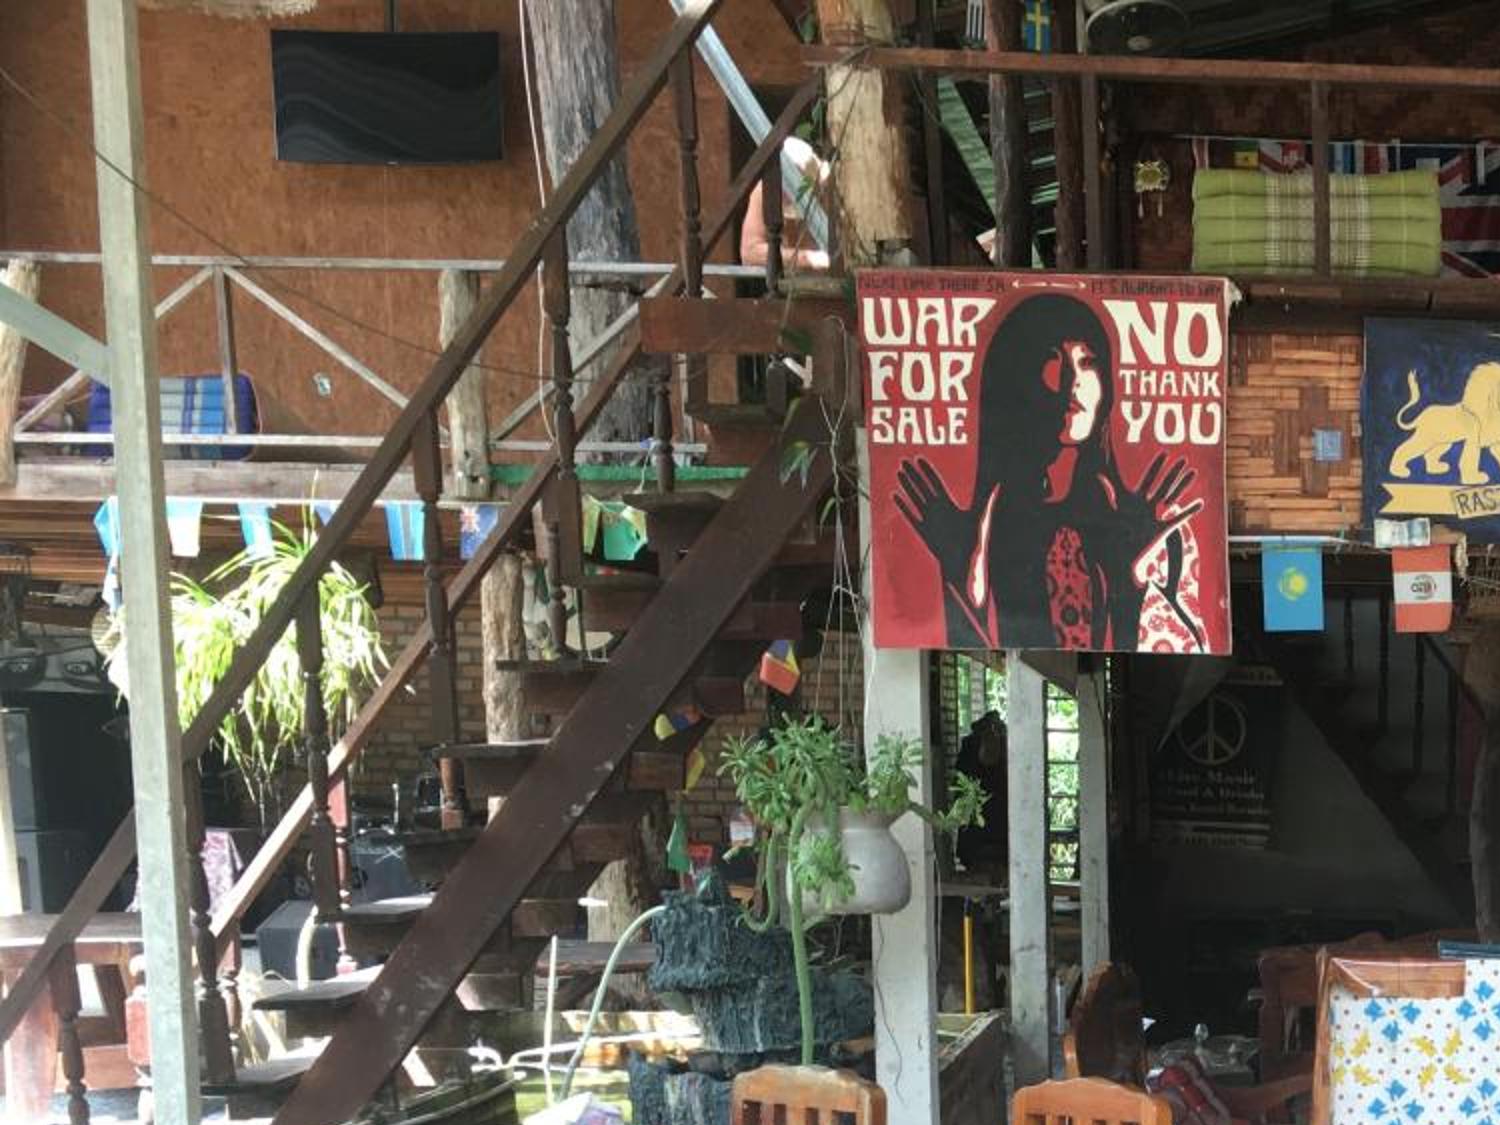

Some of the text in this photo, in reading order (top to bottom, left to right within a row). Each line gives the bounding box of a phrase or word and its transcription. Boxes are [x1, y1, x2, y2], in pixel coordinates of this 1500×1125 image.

[863, 297, 997, 347] WAR
[1102, 300, 1222, 365] NO
[868, 351, 975, 401] FOR
[1119, 370, 1221, 398] THANK
[872, 407, 968, 445] SALE
[1120, 401, 1222, 444] YOU
